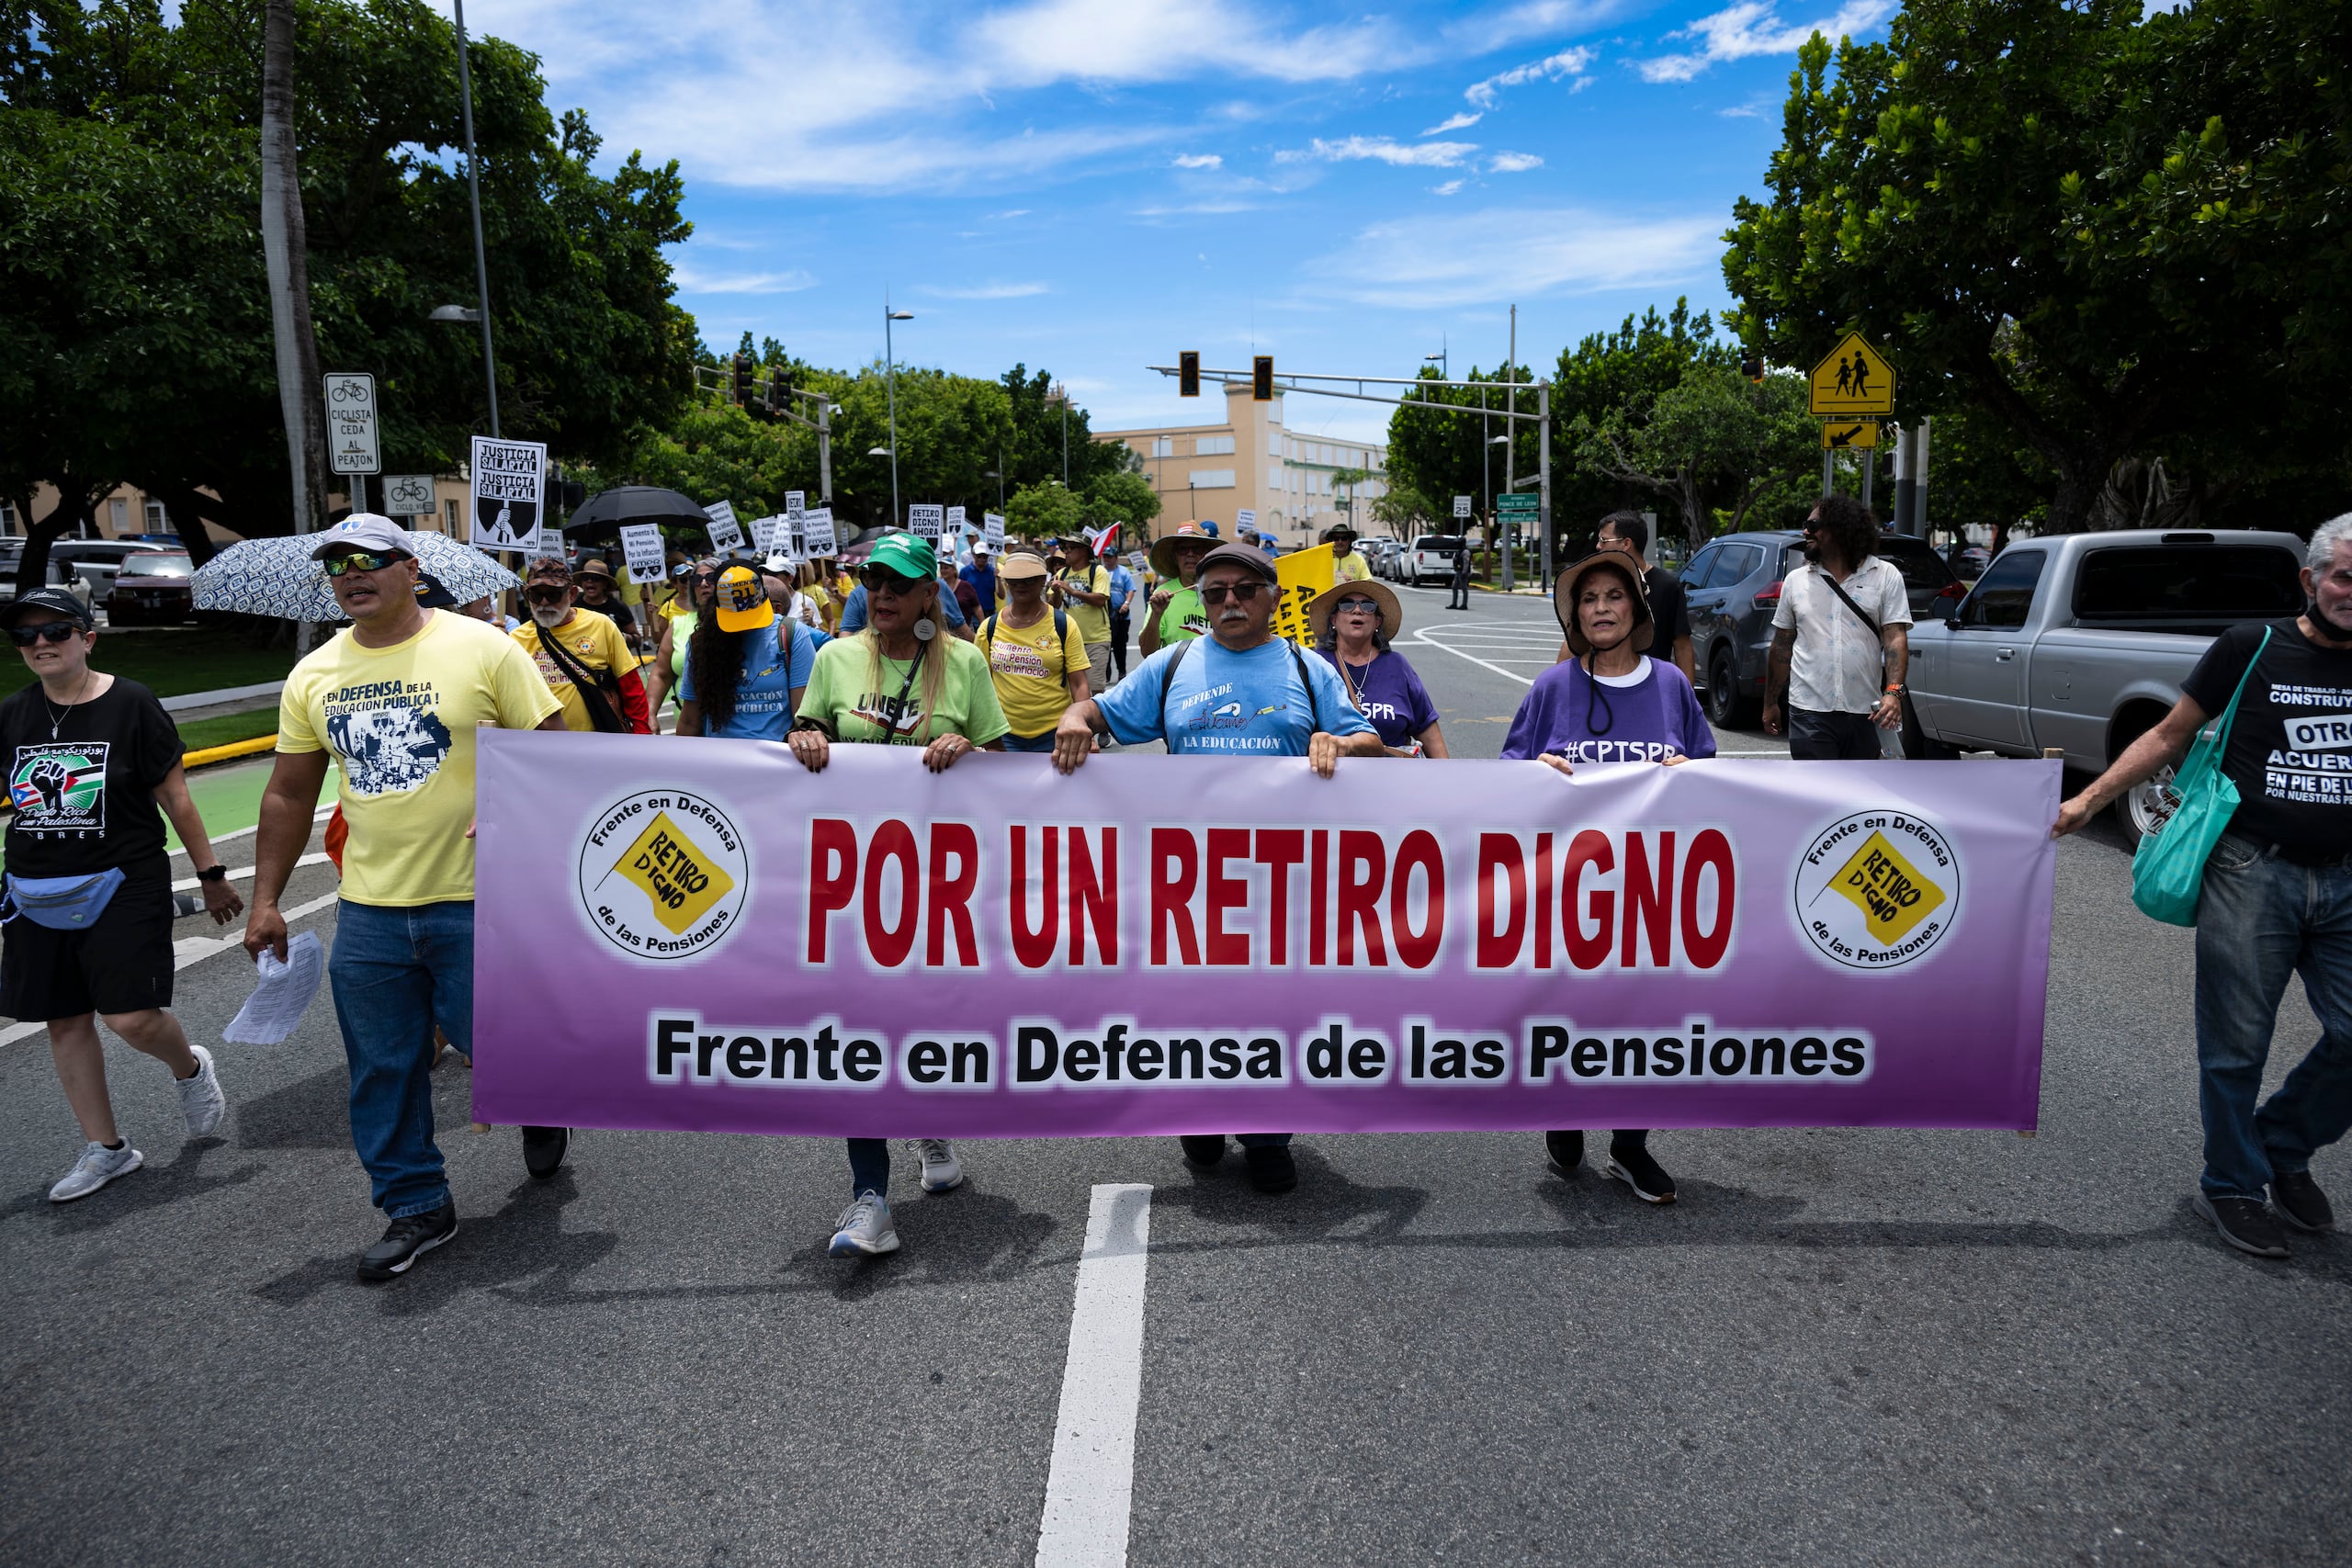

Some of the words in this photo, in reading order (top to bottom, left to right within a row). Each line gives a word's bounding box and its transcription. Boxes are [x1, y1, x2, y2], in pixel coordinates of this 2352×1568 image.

[332, 410, 372, 420] CICLISTA
[341, 425, 365, 434] CEDA
[348, 440, 360, 450] AL
[481, 445, 537, 461] JUSTICIA
[481, 456, 537, 474] SALARIAL
[481, 472, 536, 488] JUSTICIA
[480, 483, 536, 501] SALARIAL
[912, 509, 939, 518] RETIRO
[912, 518, 939, 526] DIGNO
[628, 530, 650, 538] Aumento
[913, 527, 939, 536] AHORA
[631, 558, 661, 568] FMPR
[994, 642, 1032, 653] Aumento
[1003, 663, 1011, 672] la
[1009, 653, 1042, 666] Pensión
[339, 680, 402, 703] DEFENSA
[407, 683, 418, 694] DE
[420, 682, 432, 692] LA
[736, 691, 783, 701] CACIÓN
[1182, 682, 1233, 711] DEFIENDE
[2271, 683, 2291, 692] MESA
[2304, 686, 2336, 694] TRABAJO
[1360, 703, 1396, 720] SPR
[2296, 722, 2352, 743] OTR
[1183, 737, 1198, 748] LA
[1202, 735, 1282, 750] EDUCACIÓN
[2267, 750, 2352, 770] ACUER
[2267, 772, 2287, 788] EN
[2291, 775, 2316, 792] PIE
[2321, 778, 2340, 793] DE
[2345, 779, 2352, 794] L
[2265, 787, 2285, 798] POR
[2288, 791, 2341, 805] NUESTRAS
[59, 807, 90, 817] Rico
[36, 817, 97, 826] Palestina
[591, 803, 643, 847] Frente
[648, 797, 670, 808] en
[677, 796, 736, 852] Defensa
[1807, 823, 1859, 865] Frente
[1864, 818, 1886, 828] en
[1893, 816, 1949, 867] Defensa
[649, 830, 708, 894] RETIRO
[634, 852, 685, 909] DIGNO
[1862, 849, 1921, 907] RETIRO
[808, 818, 980, 968] POR
[1010, 825, 1118, 969] UN
[1150, 828, 1445, 970] RETIRO
[1476, 828, 1736, 970] DIGNO
[1848, 870, 1897, 922] DIGNO
[598, 905, 616, 926] de
[616, 923, 641, 946] las
[646, 908, 729, 952] Pensiones
[1812, 920, 1829, 940] de
[1828, 938, 1853, 957] las
[1857, 921, 1939, 962] Pensiones
[657, 1020, 883, 1082] Frente
[907, 1041, 989, 1083] en
[1017, 1024, 1283, 1083] Defensa
[1306, 1024, 1386, 1078] de
[1409, 1025, 1506, 1078] las
[1530, 1024, 1866, 1077] Pensiones
